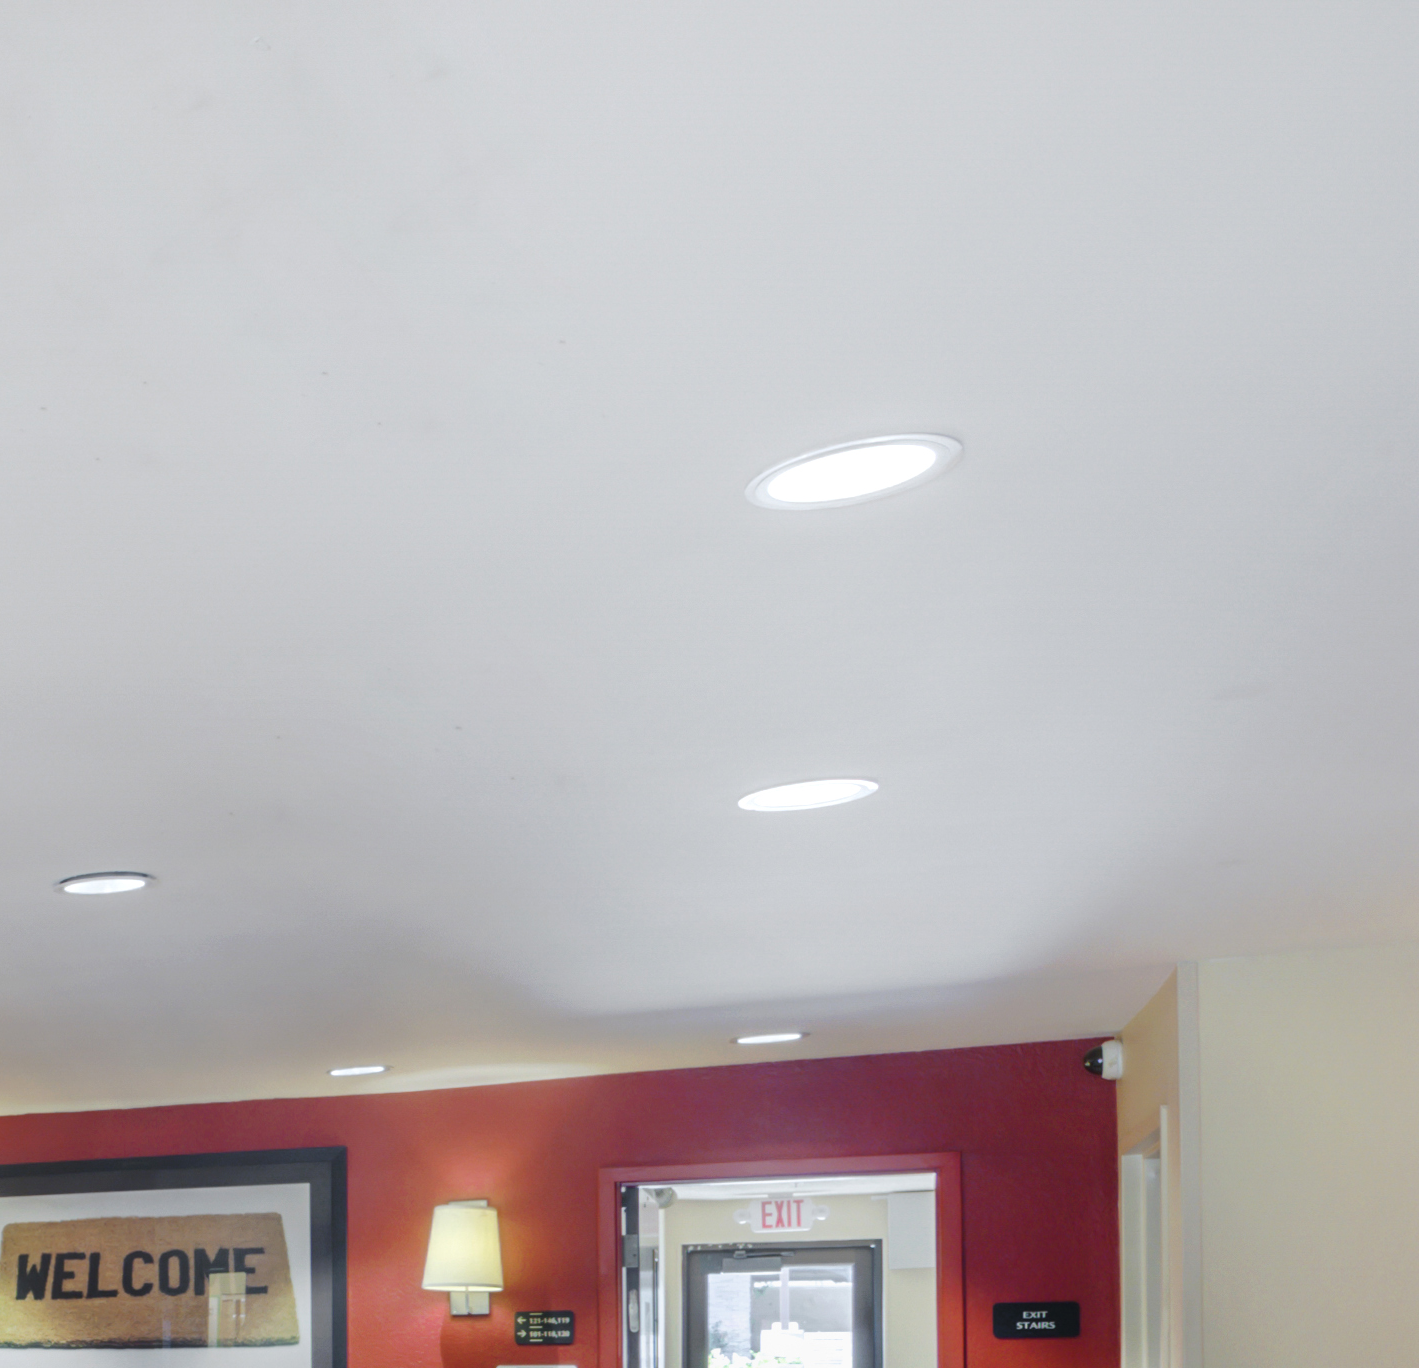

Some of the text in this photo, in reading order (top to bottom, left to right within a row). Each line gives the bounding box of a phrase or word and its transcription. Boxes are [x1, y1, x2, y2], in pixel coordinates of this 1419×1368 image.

[762, 1200, 804, 1229] EXIT
[15, 1247, 268, 1301] WELCOME
[1023, 1311, 1048, 1319] EXIT
[1016, 1321, 1056, 1330] STAIRS
